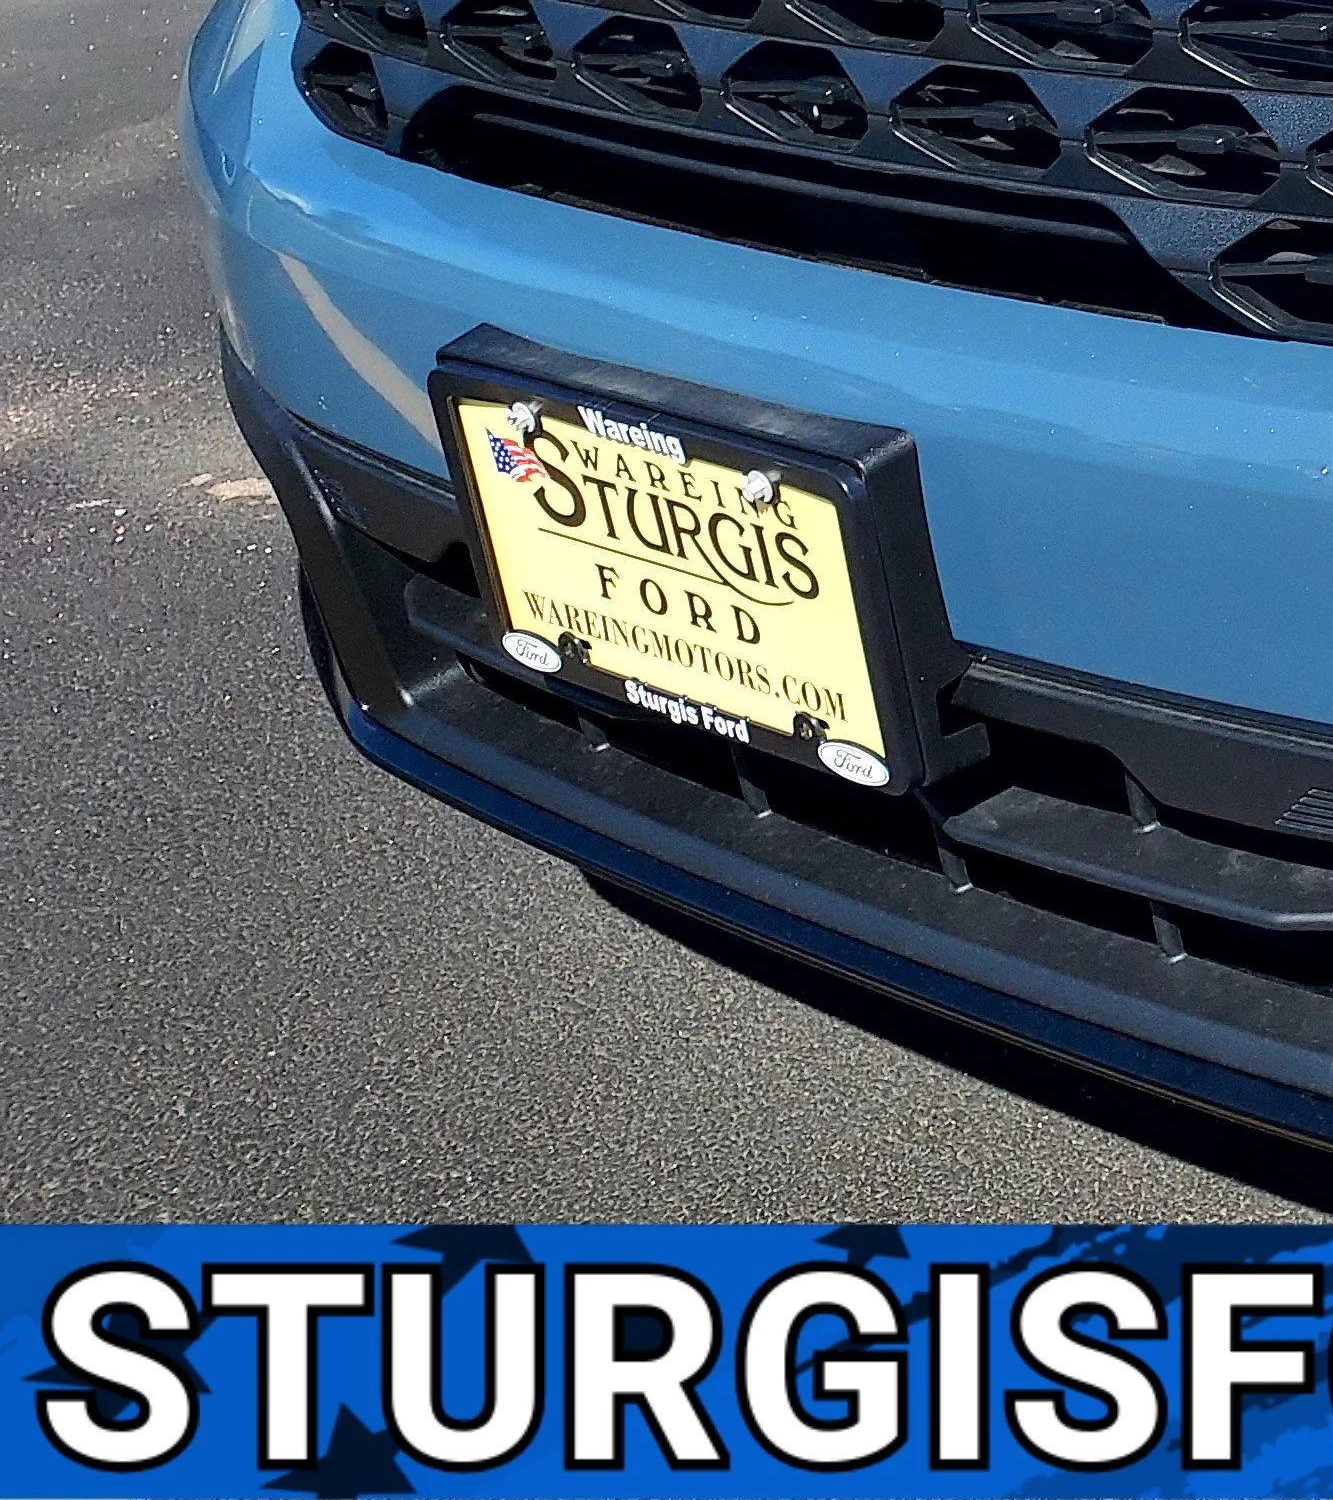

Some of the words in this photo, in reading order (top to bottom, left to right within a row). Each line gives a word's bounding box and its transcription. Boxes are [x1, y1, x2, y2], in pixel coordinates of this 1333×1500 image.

[576, 404, 687, 465] Wareing
[523, 427, 820, 605] STURGIS
[594, 562, 761, 645] FORD
[522, 590, 848, 723] WAREINGMOTORS.COM
[624, 678, 699, 725] Sturgis
[699, 704, 751, 745] Ford
